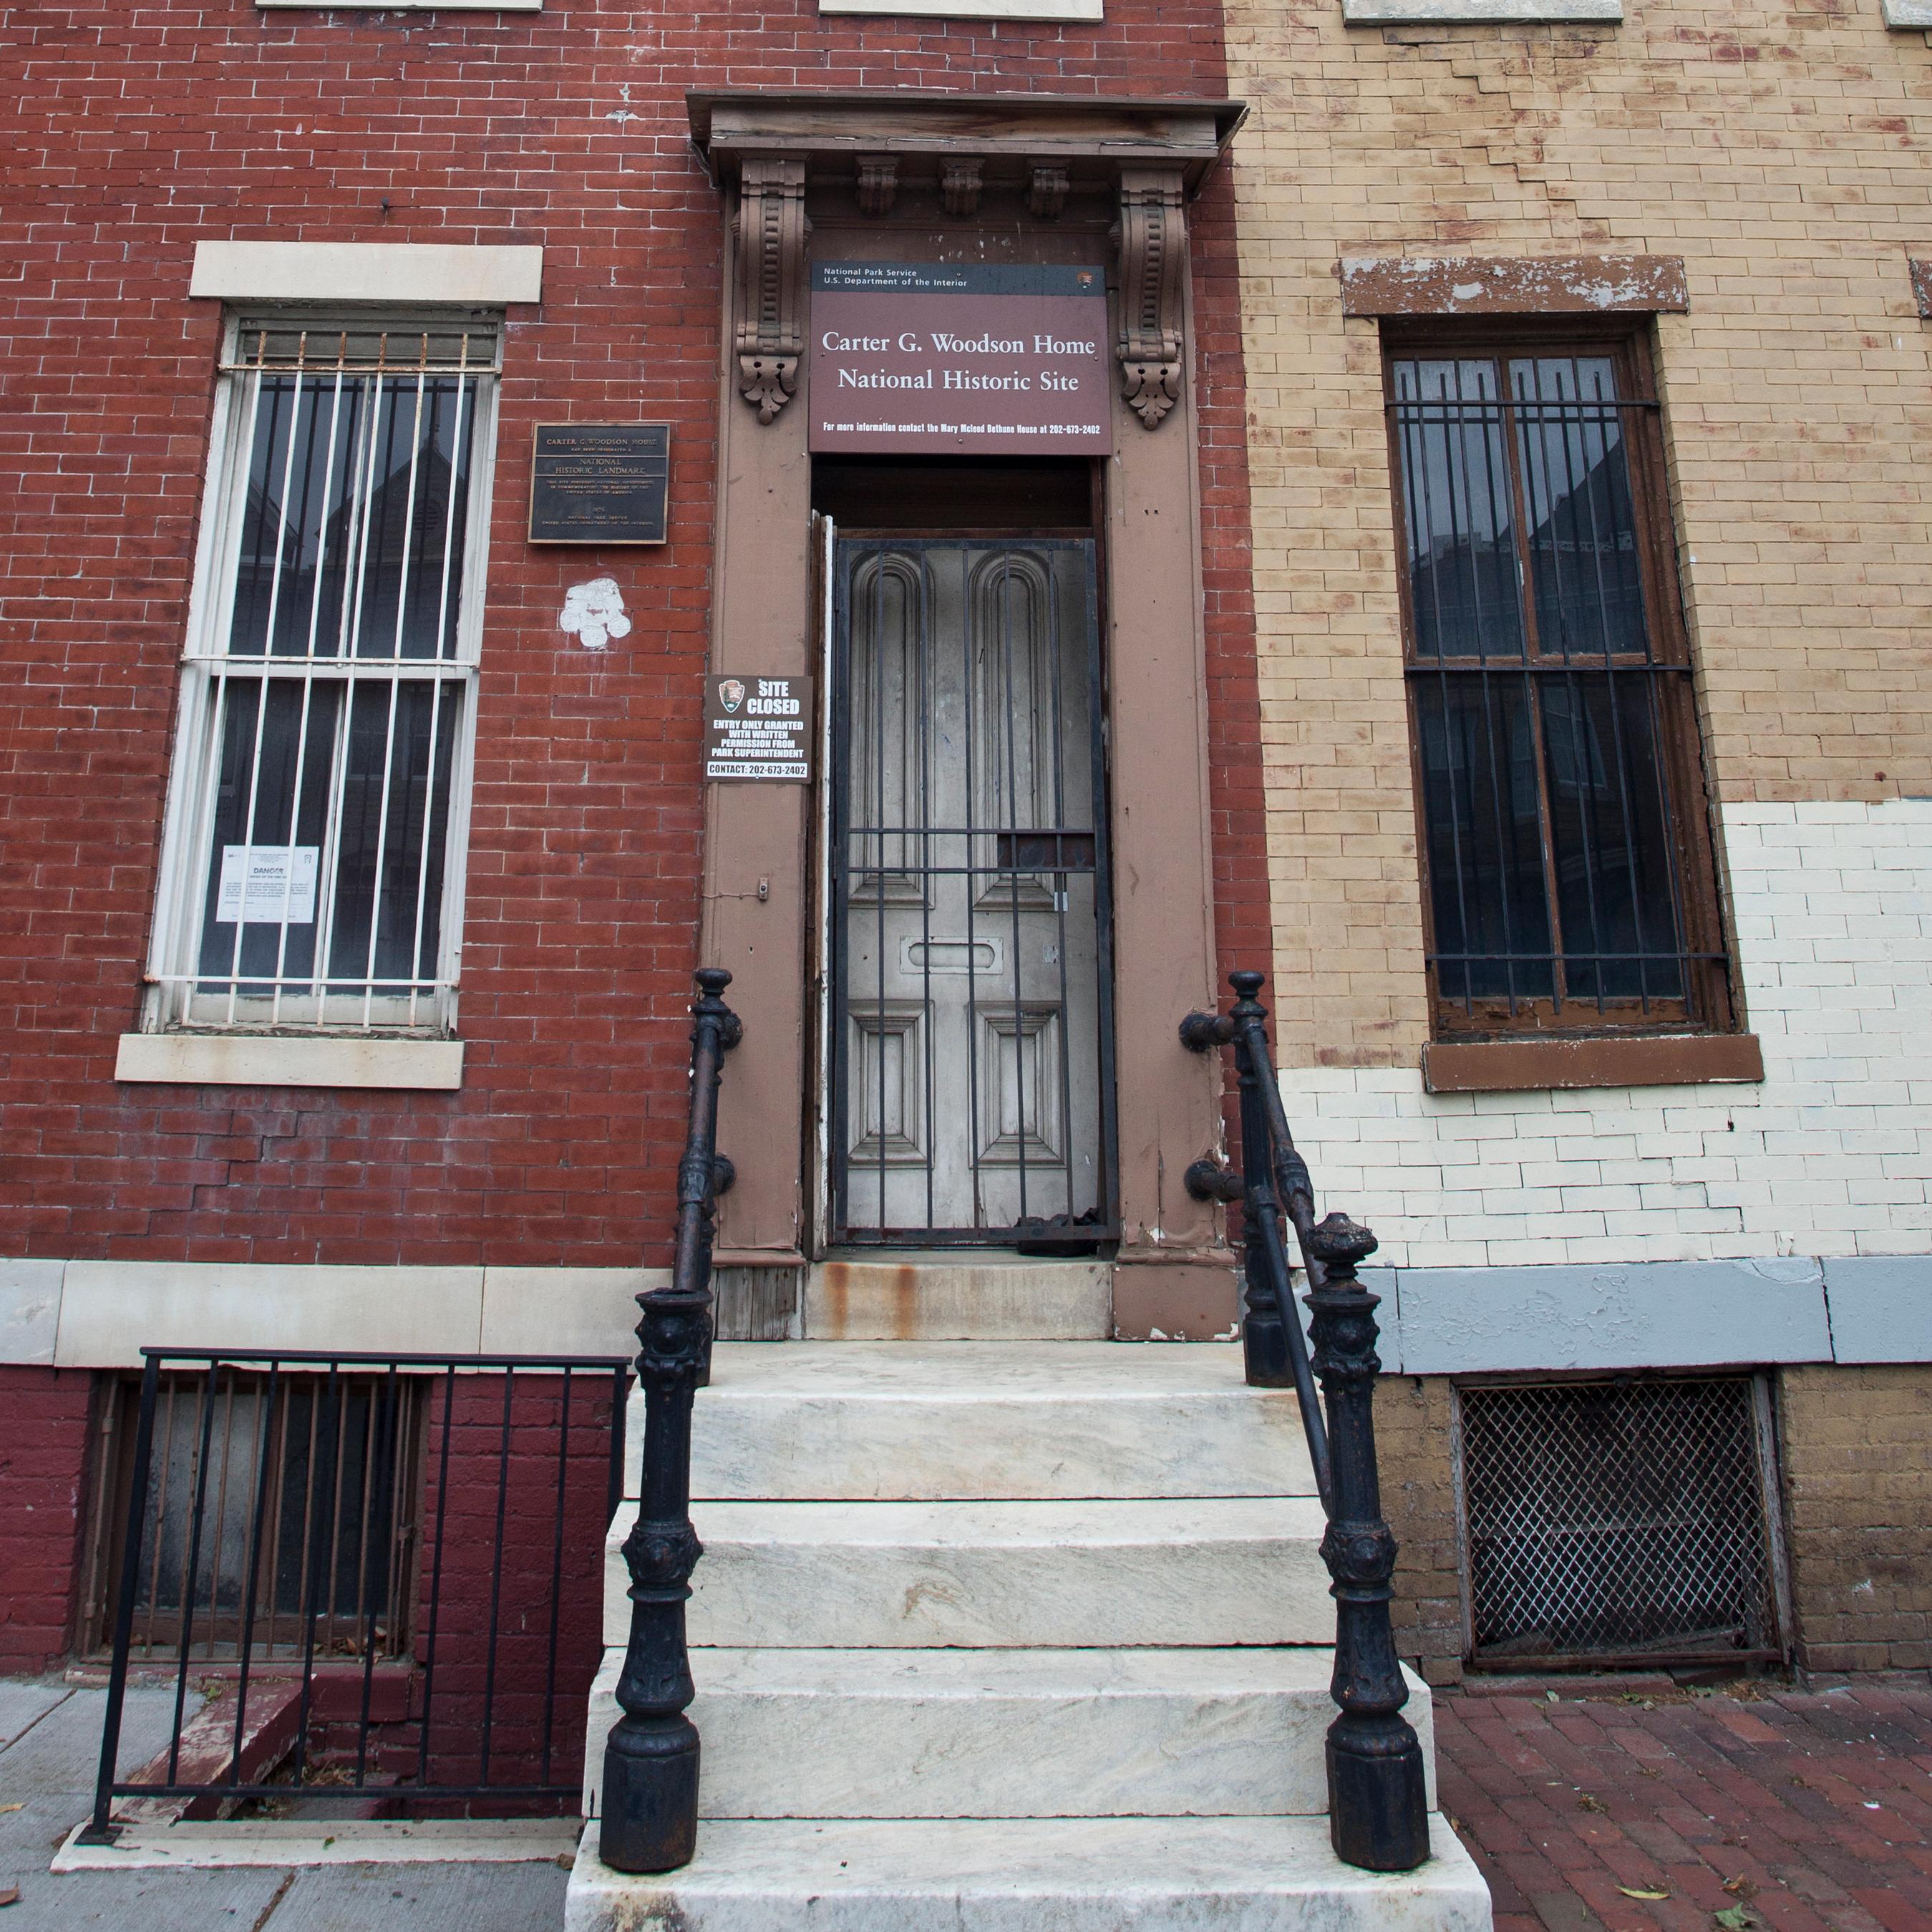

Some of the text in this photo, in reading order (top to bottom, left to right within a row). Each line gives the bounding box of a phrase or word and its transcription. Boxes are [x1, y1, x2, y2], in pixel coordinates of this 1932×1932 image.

[824, 268, 861, 276] National
[845, 277, 897, 287] Department
[822, 332, 1095, 354] Carter G. Woodson Home
[838, 369, 1079, 391] National Historic Site
[823, 422, 835, 432] For
[857, 422, 896, 432] information
[898, 424, 926, 432] contact
[928, 424, 938, 432] the
[941, 424, 958, 435] Mary
[988, 424, 1015, 434] Bethune
[1017, 424, 1037, 434] House
[1039, 425, 1047, 434] at
[1049, 425, 1100, 435] 202-673-2402
[759, 681, 789, 696] SITE
[747, 699, 800, 714] CLOSED
[714, 720, 803, 730] ENTRY ONLY GRANTED
[752, 730, 788, 739] WRITTEN
[721, 739, 795, 749] PERMISSION FROM
[712, 748, 804, 758] PARK SUPERINTENDENT
[709, 764, 805, 775] CONTACT: 202-673-2402
